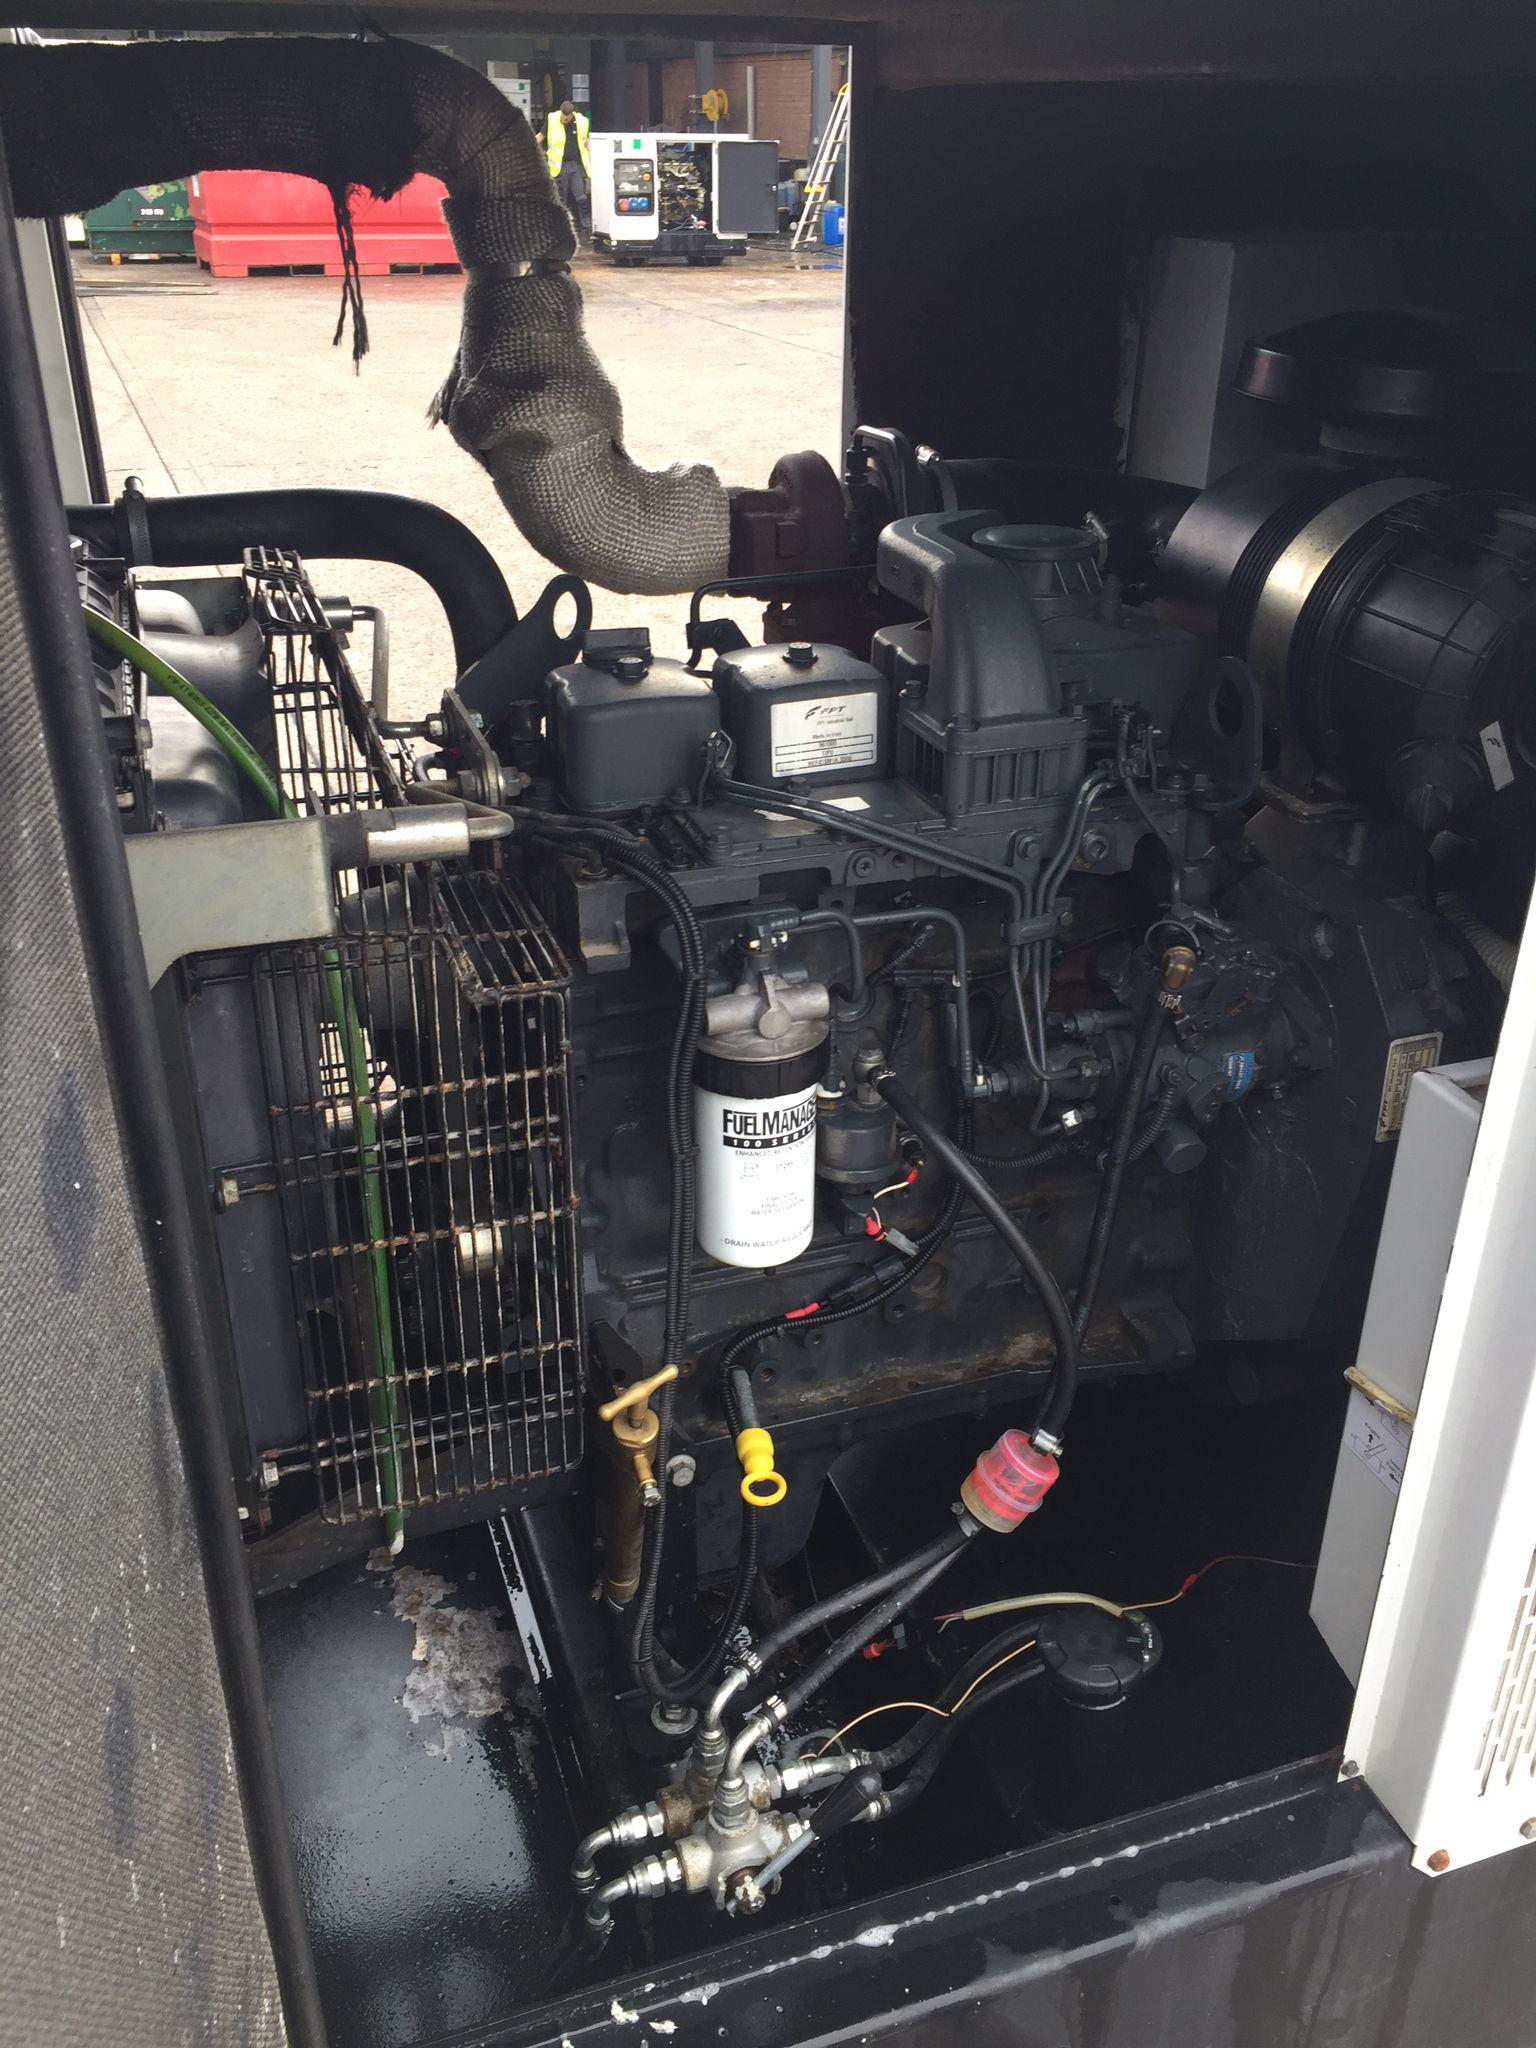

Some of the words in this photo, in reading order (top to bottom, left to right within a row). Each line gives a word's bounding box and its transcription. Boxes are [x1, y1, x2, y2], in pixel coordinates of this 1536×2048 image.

[820, 705, 847, 715] FPT
[733, 1138, 762, 1147] 100
[724, 1238, 750, 1248] DRAIN
